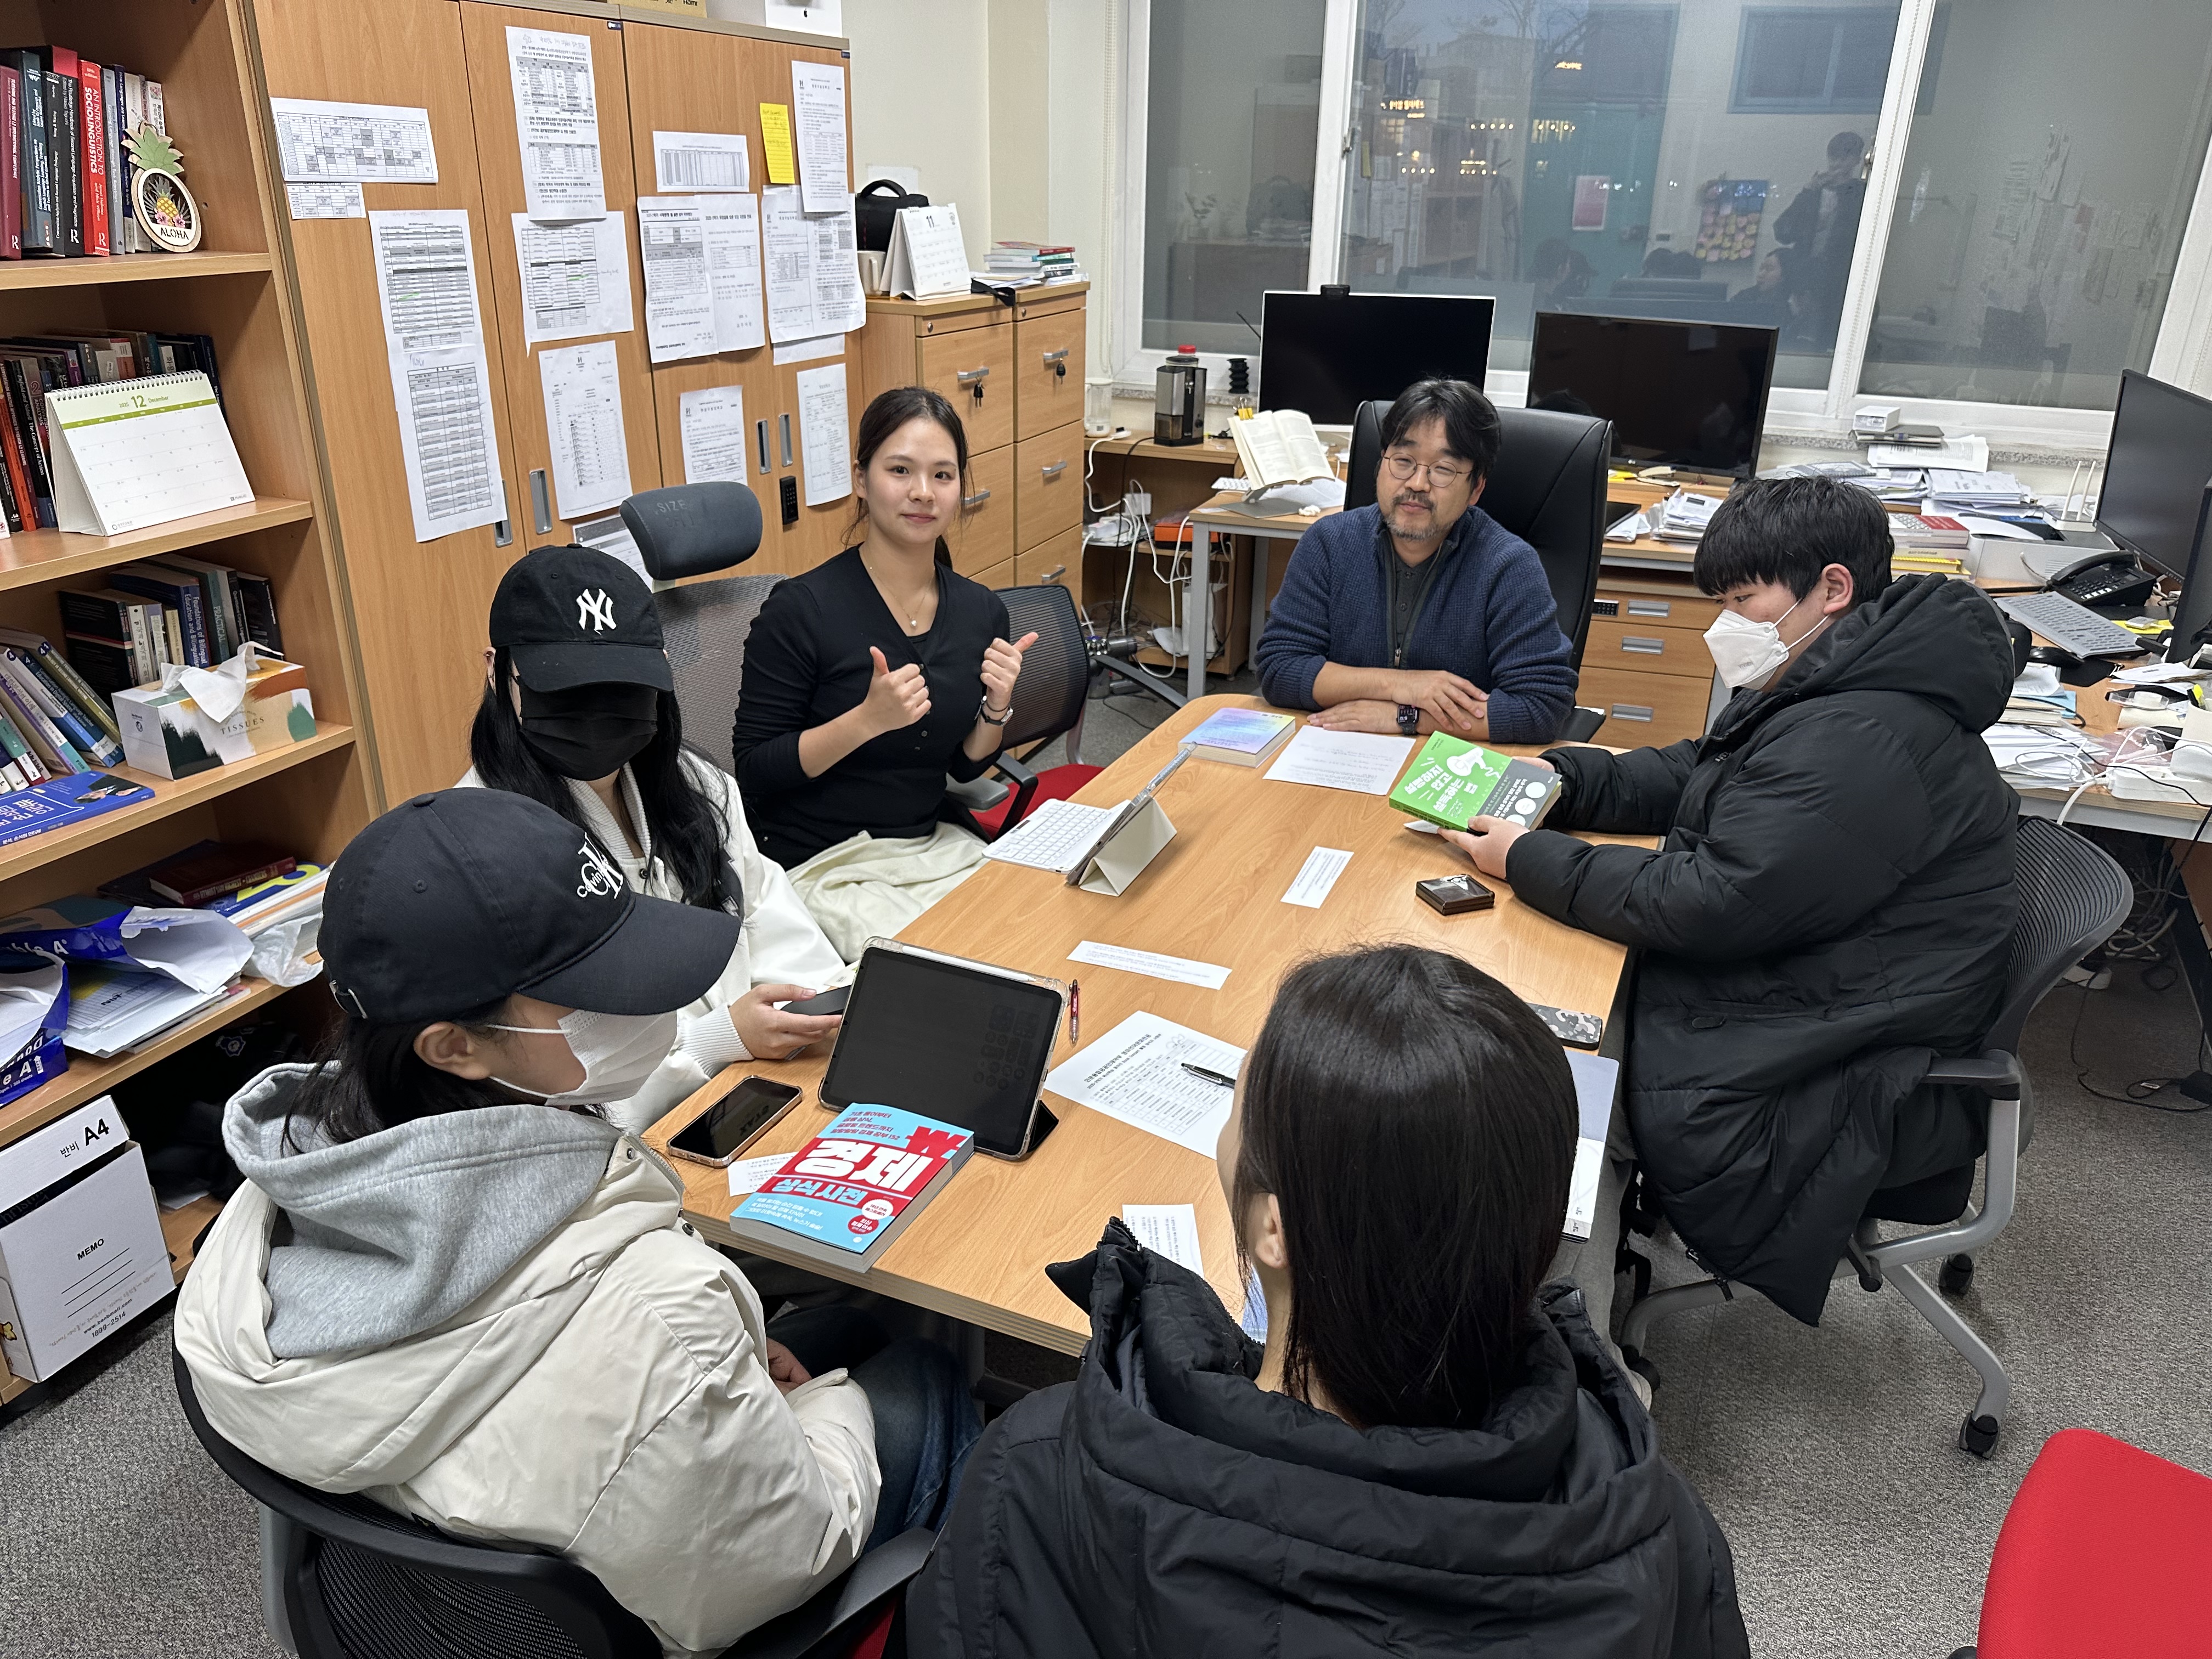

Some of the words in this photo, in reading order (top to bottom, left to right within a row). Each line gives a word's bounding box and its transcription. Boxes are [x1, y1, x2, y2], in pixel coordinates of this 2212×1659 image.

[92, 88, 99, 101] AN
[84, 87, 98, 173] SOCIOLINGUISTICS
[94, 104, 103, 163] INTRODUCTION
[98, 165, 104, 175] TO
[160, 226, 190, 241] ALOHA
[34, 398, 44, 426] ANALYSIS
[131, 395, 147, 408] 12
[31, 432, 40, 453] Concept
[184, 594, 194, 622] Education
[190, 635, 200, 668] Bilingualism
[193, 597, 202, 630] Foundations
[198, 639, 207, 664] Bilingual
[214, 606, 226, 642] PRACTICAL
[35, 670, 52, 689] Education
[220, 716, 264, 735] TISSUES
[1404, 764, 1444, 794] 설명하지
[1430, 771, 1453, 792] 않고
[1463, 781, 1479, 794] 법
[1433, 778, 1465, 812] 설득하는
[19, 1061, 31, 1077] A
[84, 1118, 110, 1147] A4
[858, 1123, 894, 1132] 트렌드까지
[60, 1141, 79, 1158] 반비
[793, 1139, 934, 1192] 경제
[771, 1178, 869, 1205] 상식사전
[77, 1238, 104, 1260] MEMO
